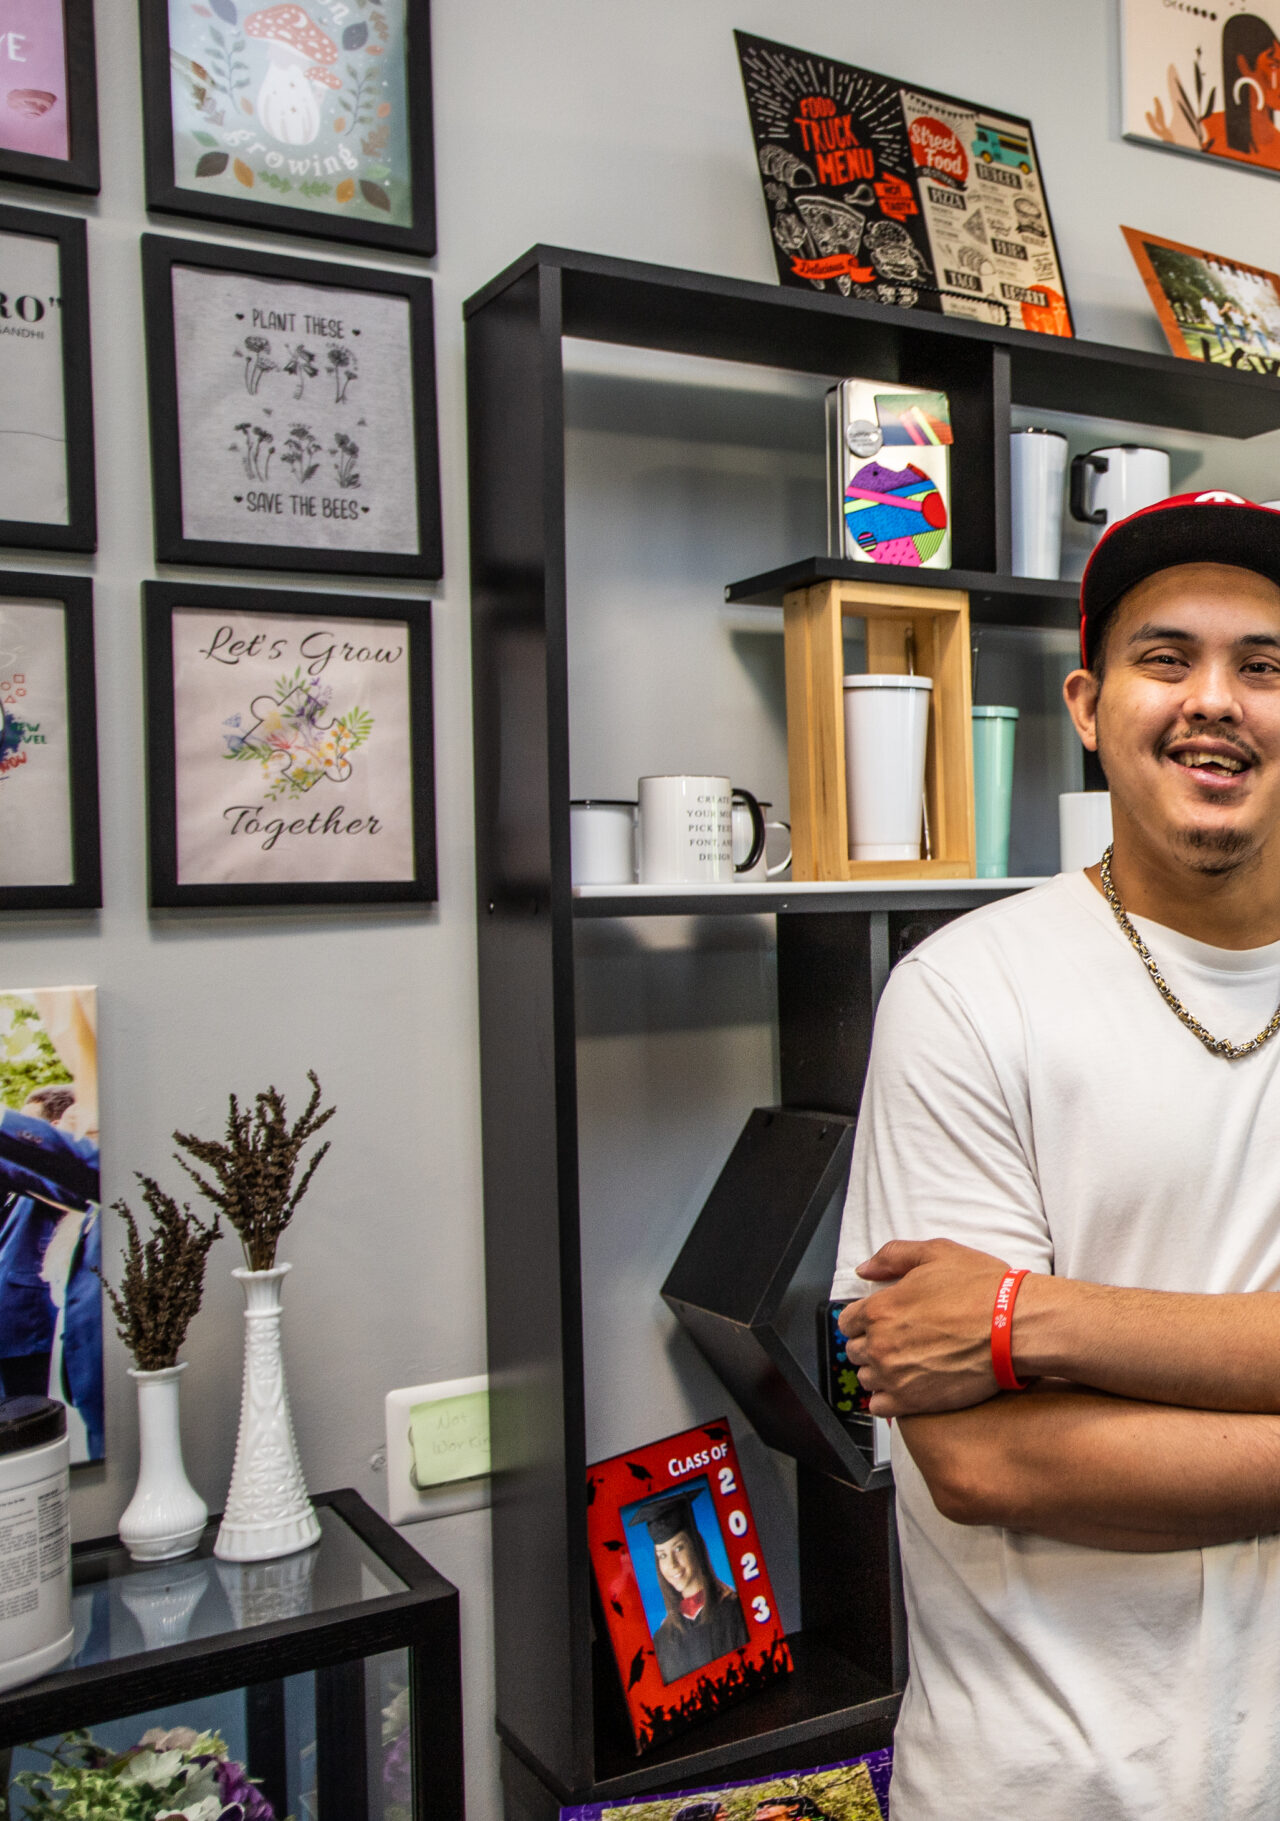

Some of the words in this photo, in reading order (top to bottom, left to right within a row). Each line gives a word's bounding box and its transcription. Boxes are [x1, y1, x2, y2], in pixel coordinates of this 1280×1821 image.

[800, 96, 837, 119] FOOD
[794, 114, 860, 152] TRUCK
[909, 122, 958, 154] Street
[224, 129, 359, 177] growing
[815, 148, 875, 186] MENU
[924, 147, 963, 176] Food
[0, 326, 45, 339] ANDHI
[252, 308, 296, 332] PLANT
[304, 314, 345, 340] THESE
[246, 491, 283, 515] SAVE
[289, 495, 316, 517] THE
[322, 498, 359, 520] BEES
[198, 625, 288, 665] Let's
[300, 631, 404, 676] Grow
[223, 805, 383, 851] Together
[688, 824, 713, 833] PICK
[668, 1450, 711, 1477] CLASS
[711, 1442, 728, 1461] OF
